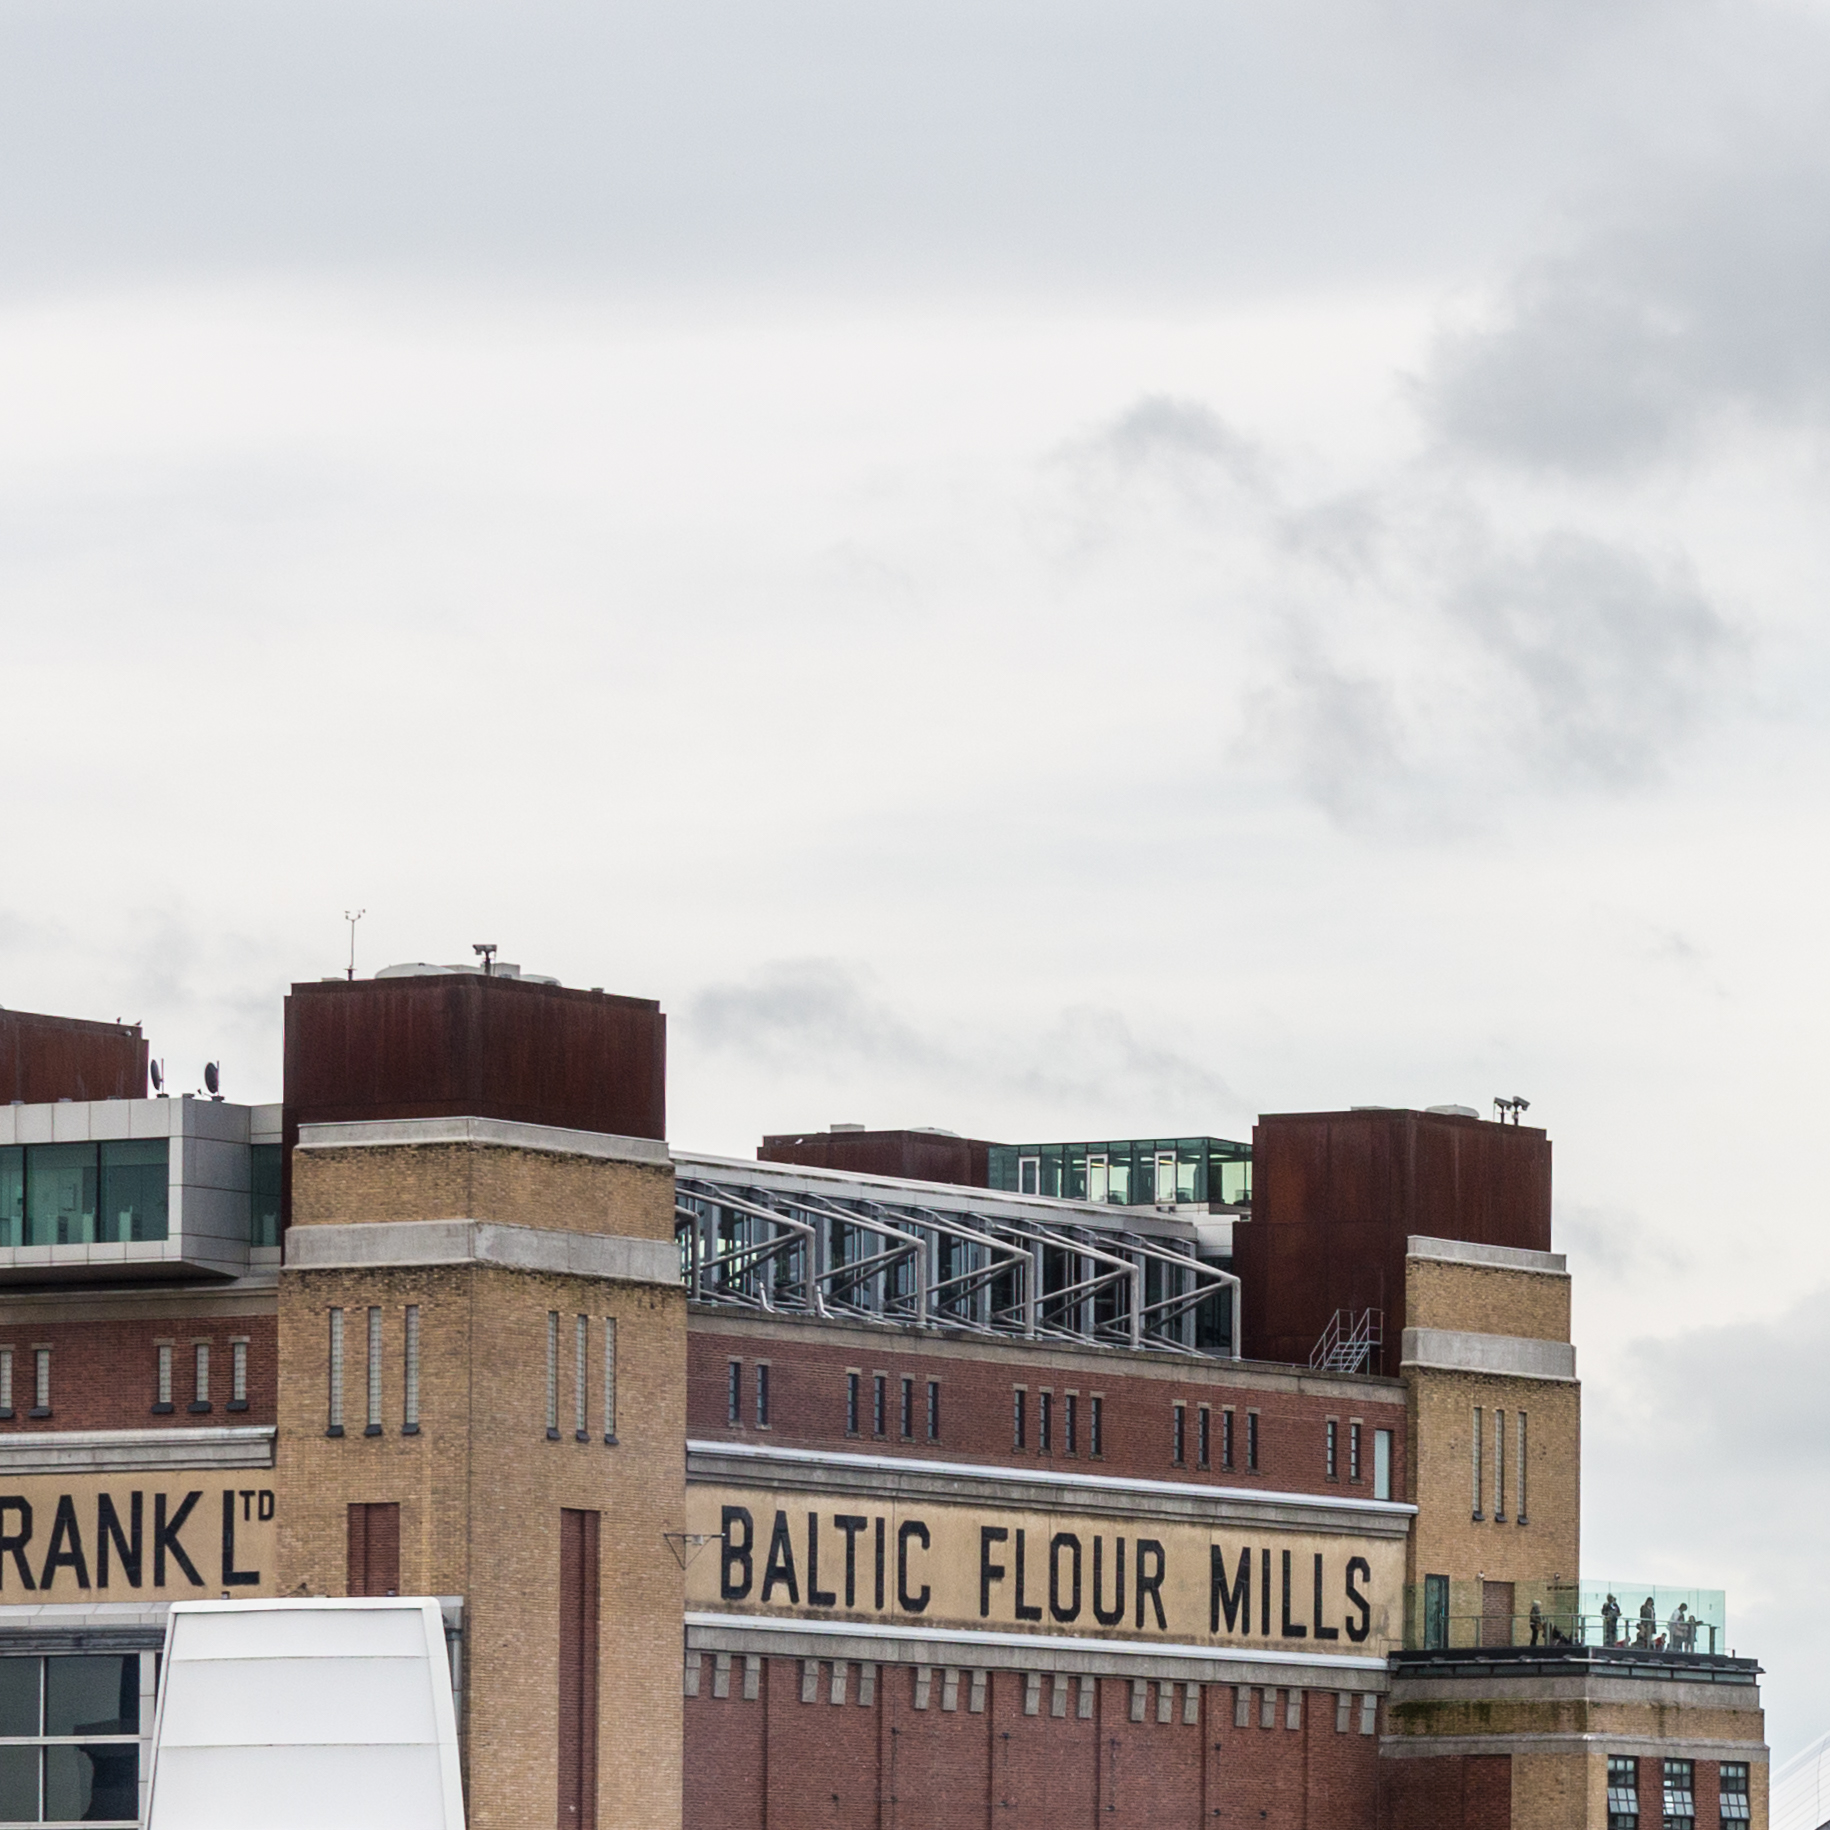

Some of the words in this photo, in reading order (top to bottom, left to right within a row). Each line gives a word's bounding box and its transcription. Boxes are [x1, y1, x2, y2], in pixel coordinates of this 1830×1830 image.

[0, 1490, 204, 1591] RANK
[720, 1504, 931, 1613] BALTIC
[980, 1525, 1169, 1630] FLOUR
[1210, 1543, 1371, 1643] MILLS
